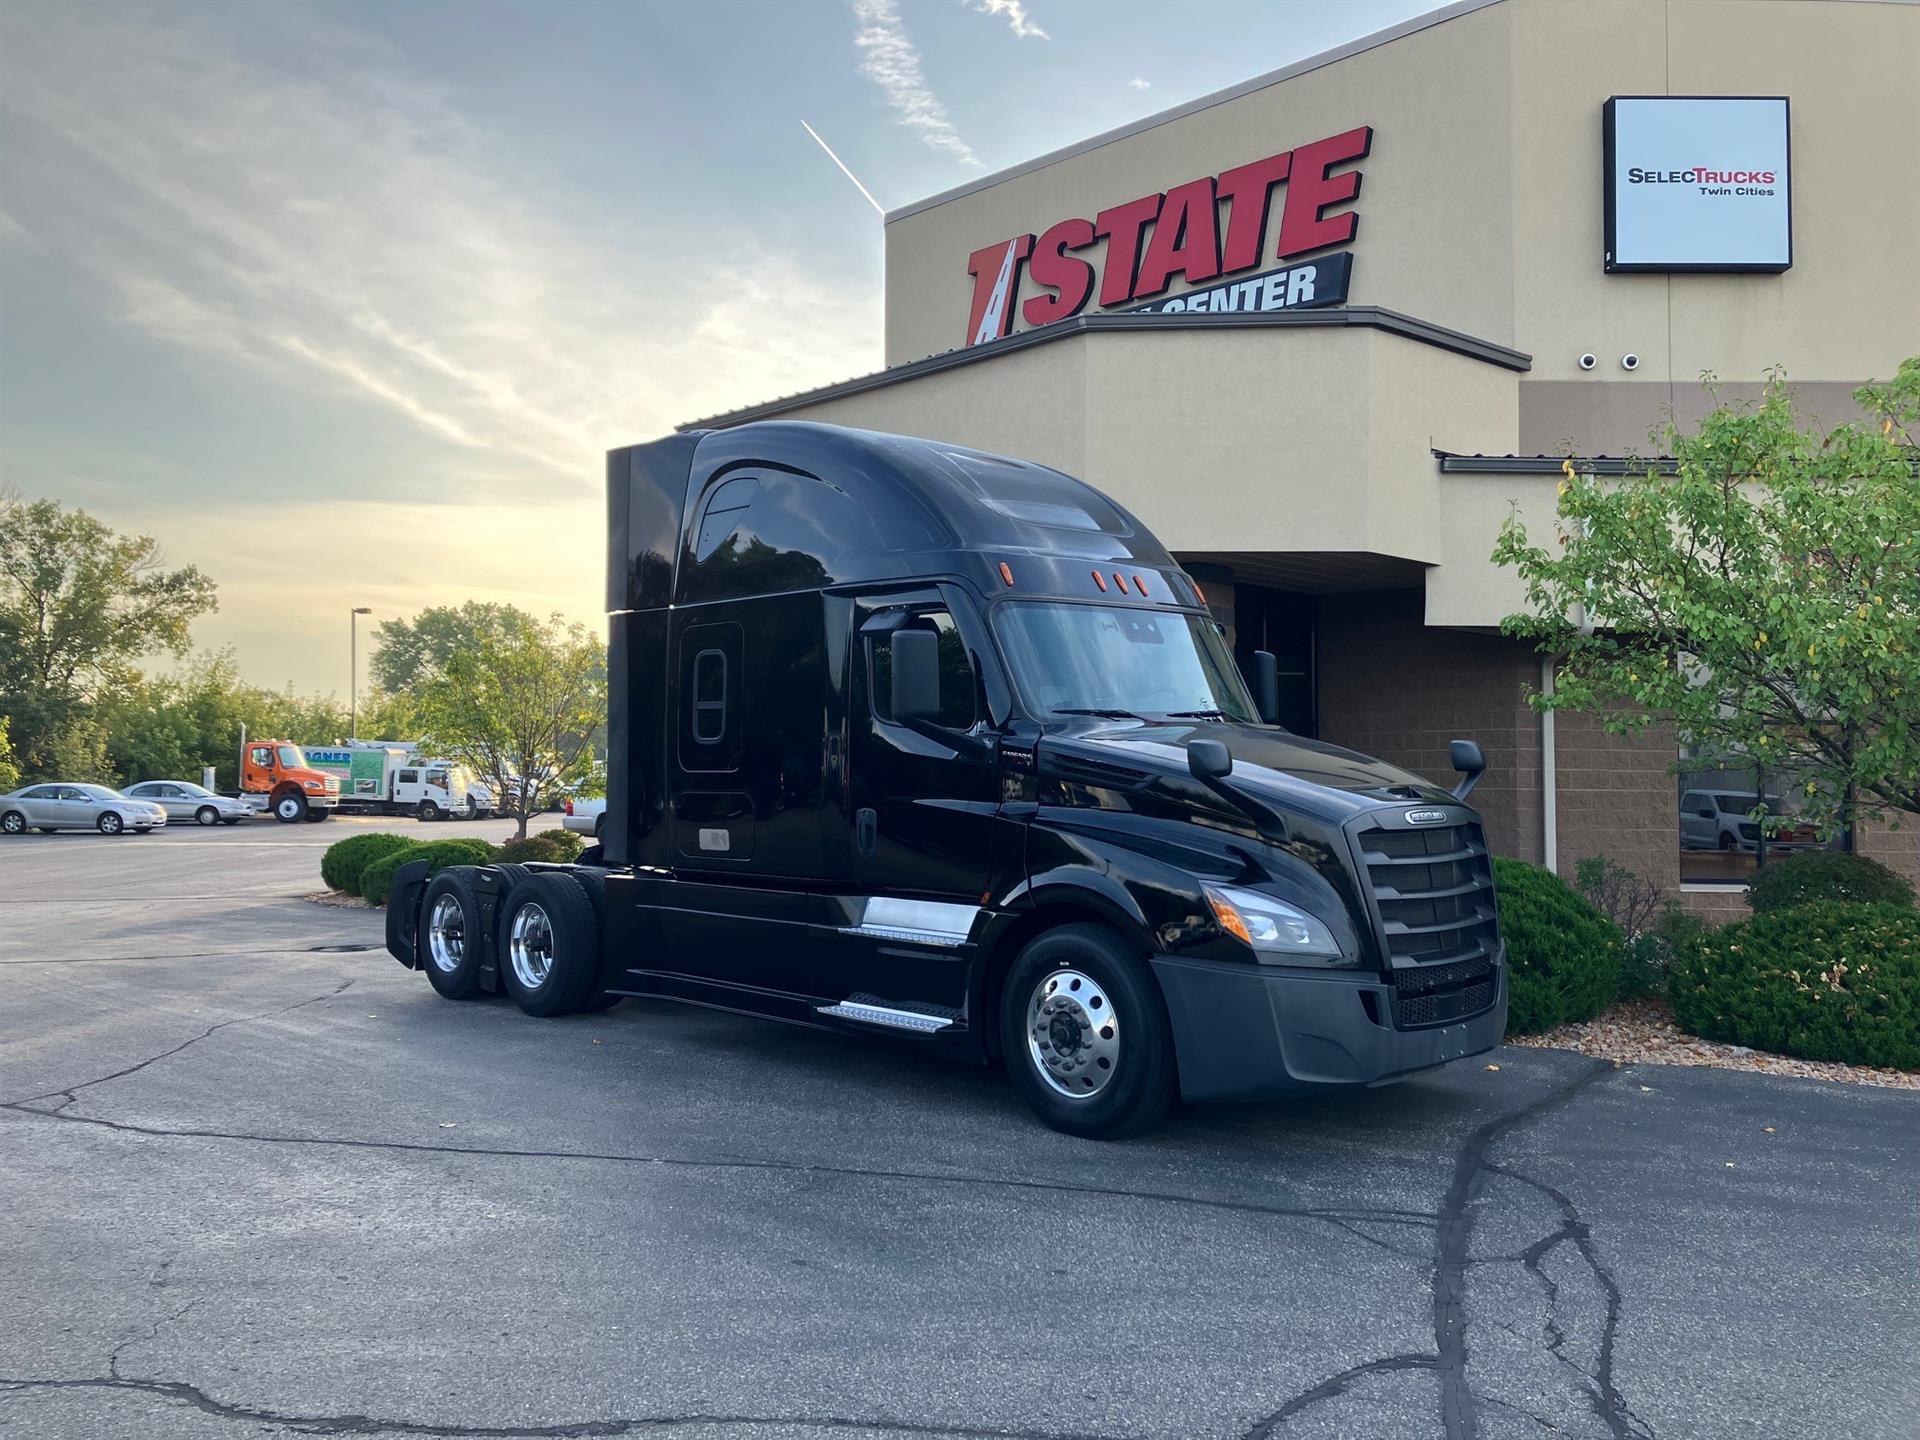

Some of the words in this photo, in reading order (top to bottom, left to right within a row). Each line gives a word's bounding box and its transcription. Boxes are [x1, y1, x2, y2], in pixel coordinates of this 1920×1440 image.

[1628, 168, 1775, 184] SELECTRUCKS
[1700, 187, 1731, 196] Twin
[1736, 187, 1775, 197] Cities
[304, 751, 351, 763] AGNER
